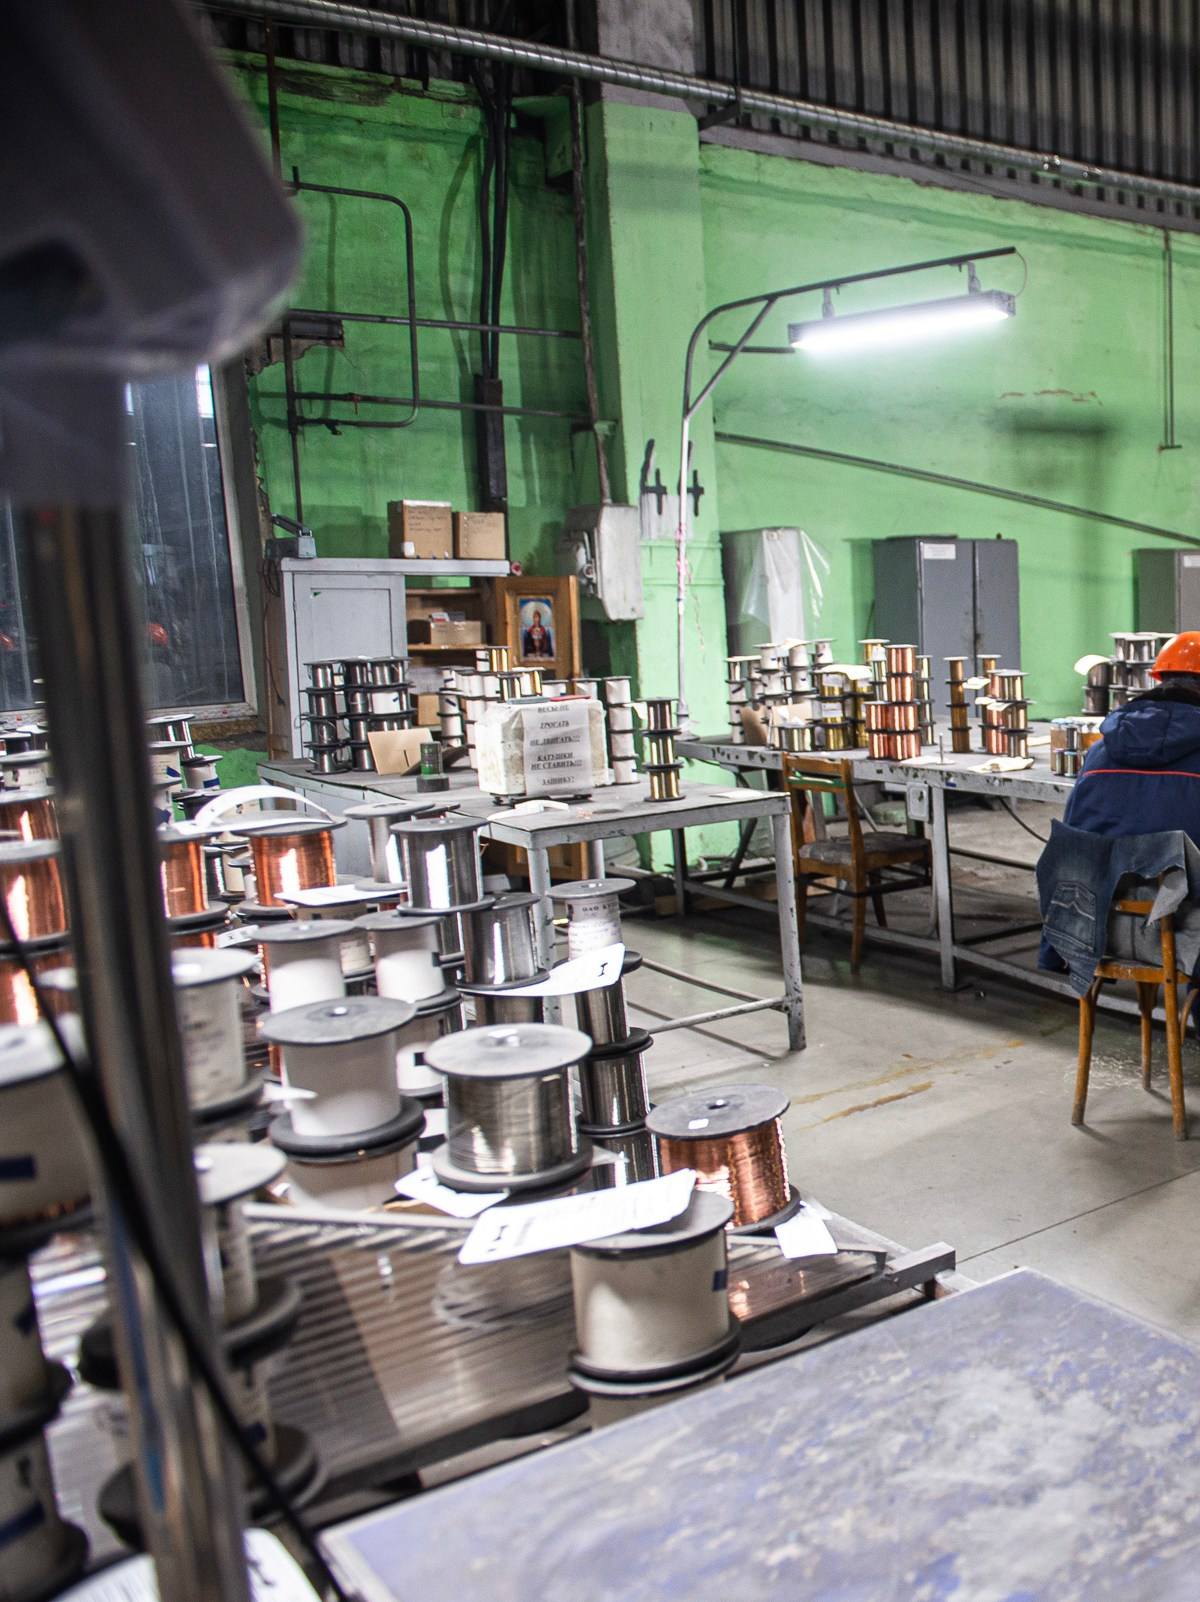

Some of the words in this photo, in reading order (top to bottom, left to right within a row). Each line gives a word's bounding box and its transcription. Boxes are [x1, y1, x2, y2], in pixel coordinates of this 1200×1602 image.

[540, 721, 570, 729] ТРОГАТЬ
[537, 752, 573, 762] КАТУШКИ
[531, 763, 541, 771] НЕ
